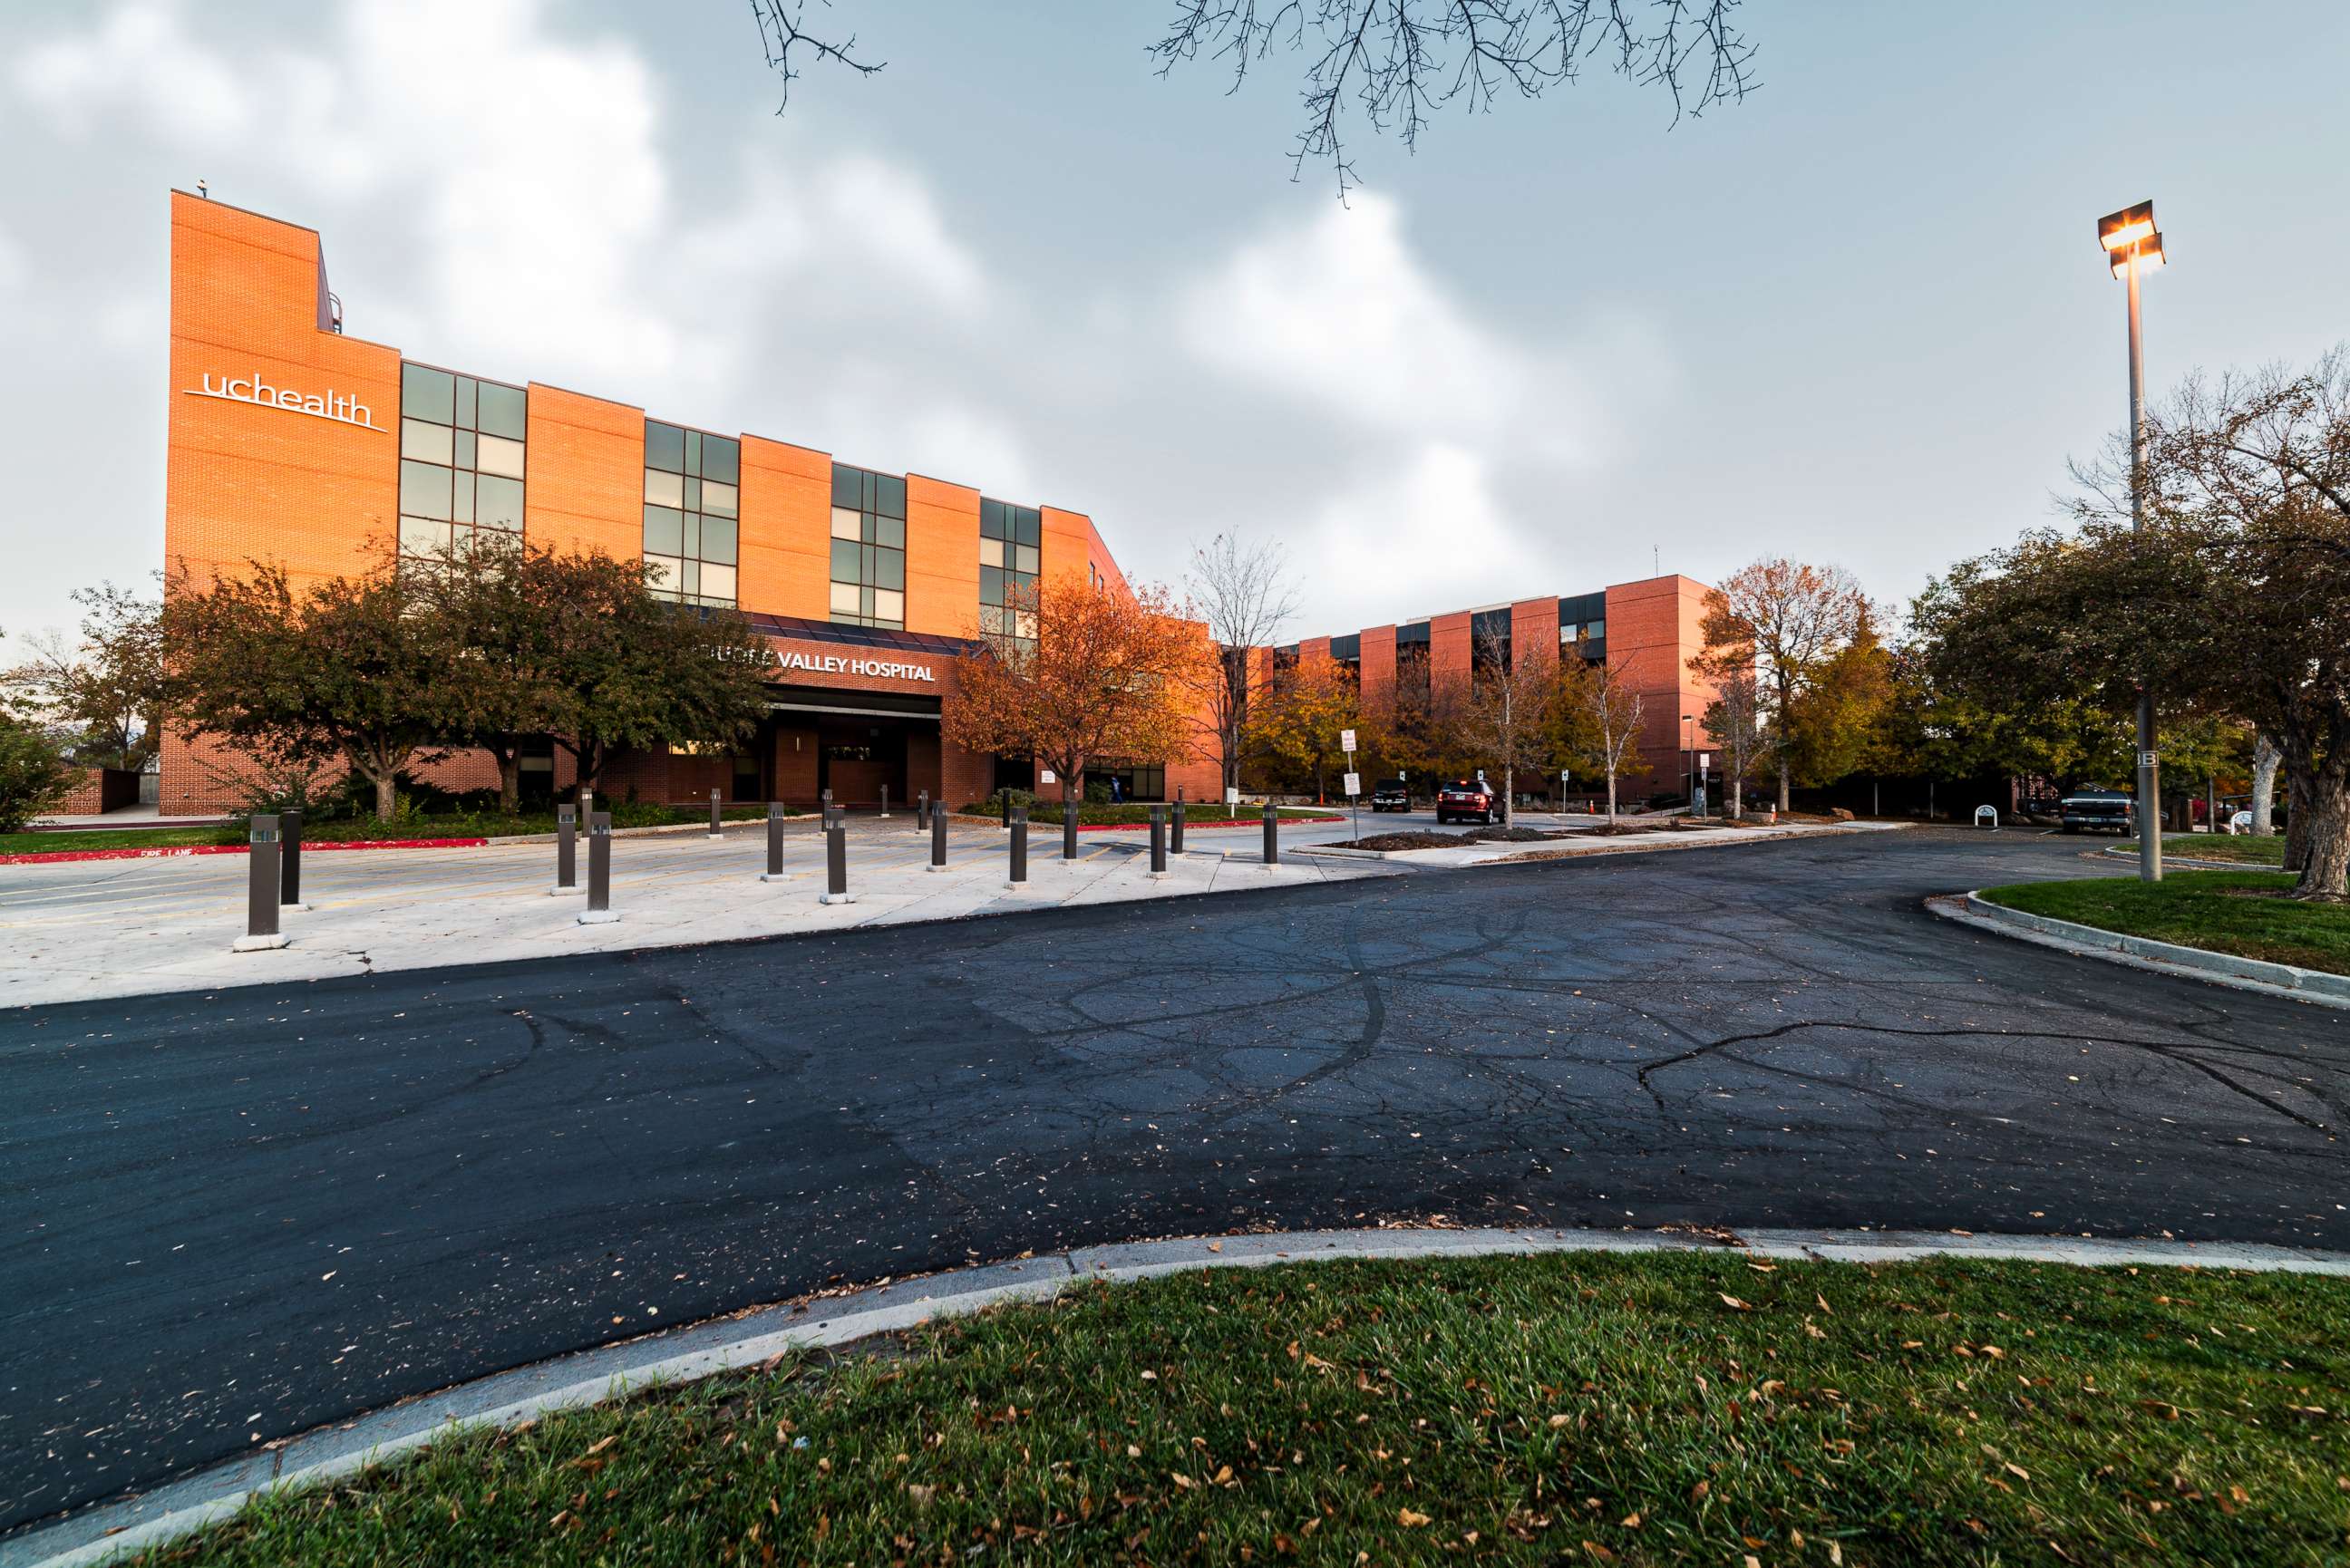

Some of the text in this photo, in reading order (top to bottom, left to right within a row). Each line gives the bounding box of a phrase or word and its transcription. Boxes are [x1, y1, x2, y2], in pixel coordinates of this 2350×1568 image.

[203, 373, 371, 427] uchealth
[777, 652, 849, 673] VALLEY
[851, 660, 936, 682] HOSPITAL
